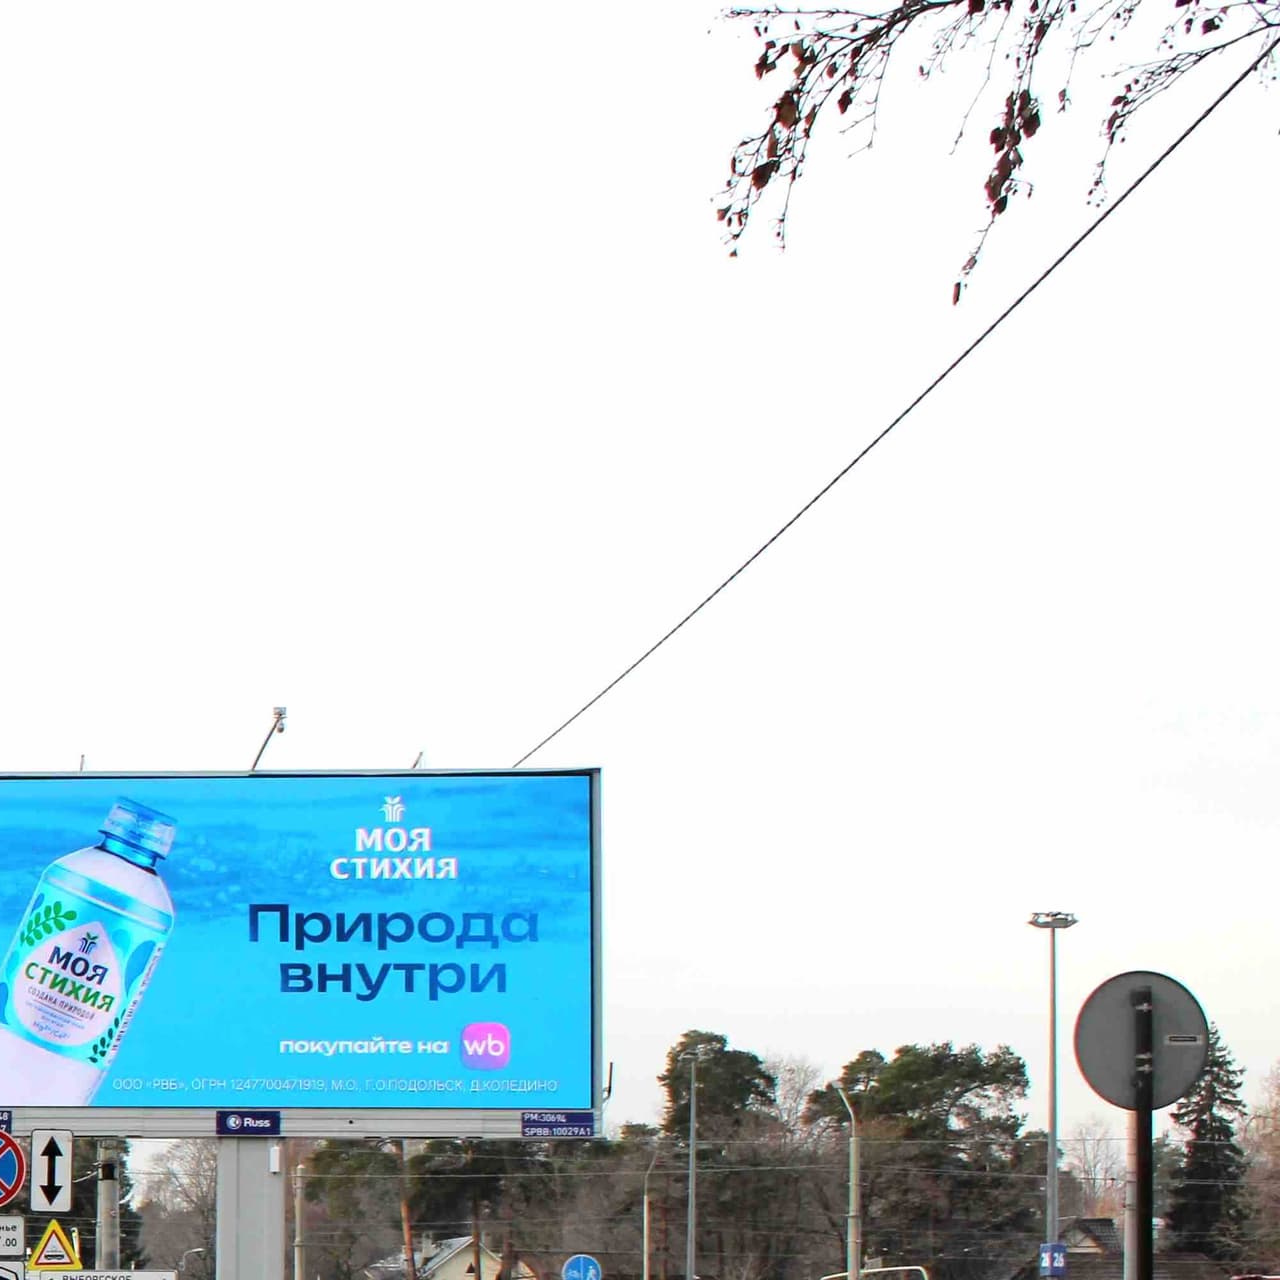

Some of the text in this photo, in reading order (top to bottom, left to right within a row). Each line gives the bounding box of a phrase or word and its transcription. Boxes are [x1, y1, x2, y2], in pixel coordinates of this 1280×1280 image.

[355, 827, 432, 852] МОЯ
[330, 857, 458, 880] СТИХИЯ
[249, 903, 539, 950] Природа
[48, 945, 109, 986] МОЯ
[25, 961, 115, 1013] СТИХИЯ
[279, 962, 507, 1002] внутри
[279, 1036, 450, 1056] покупайте на
[463, 1032, 505, 1057] wb
[112, 1078, 143, 1090] ООО
[191, 1078, 226, 1090] ОГРН
[243, 1116, 271, 1128] Russ
